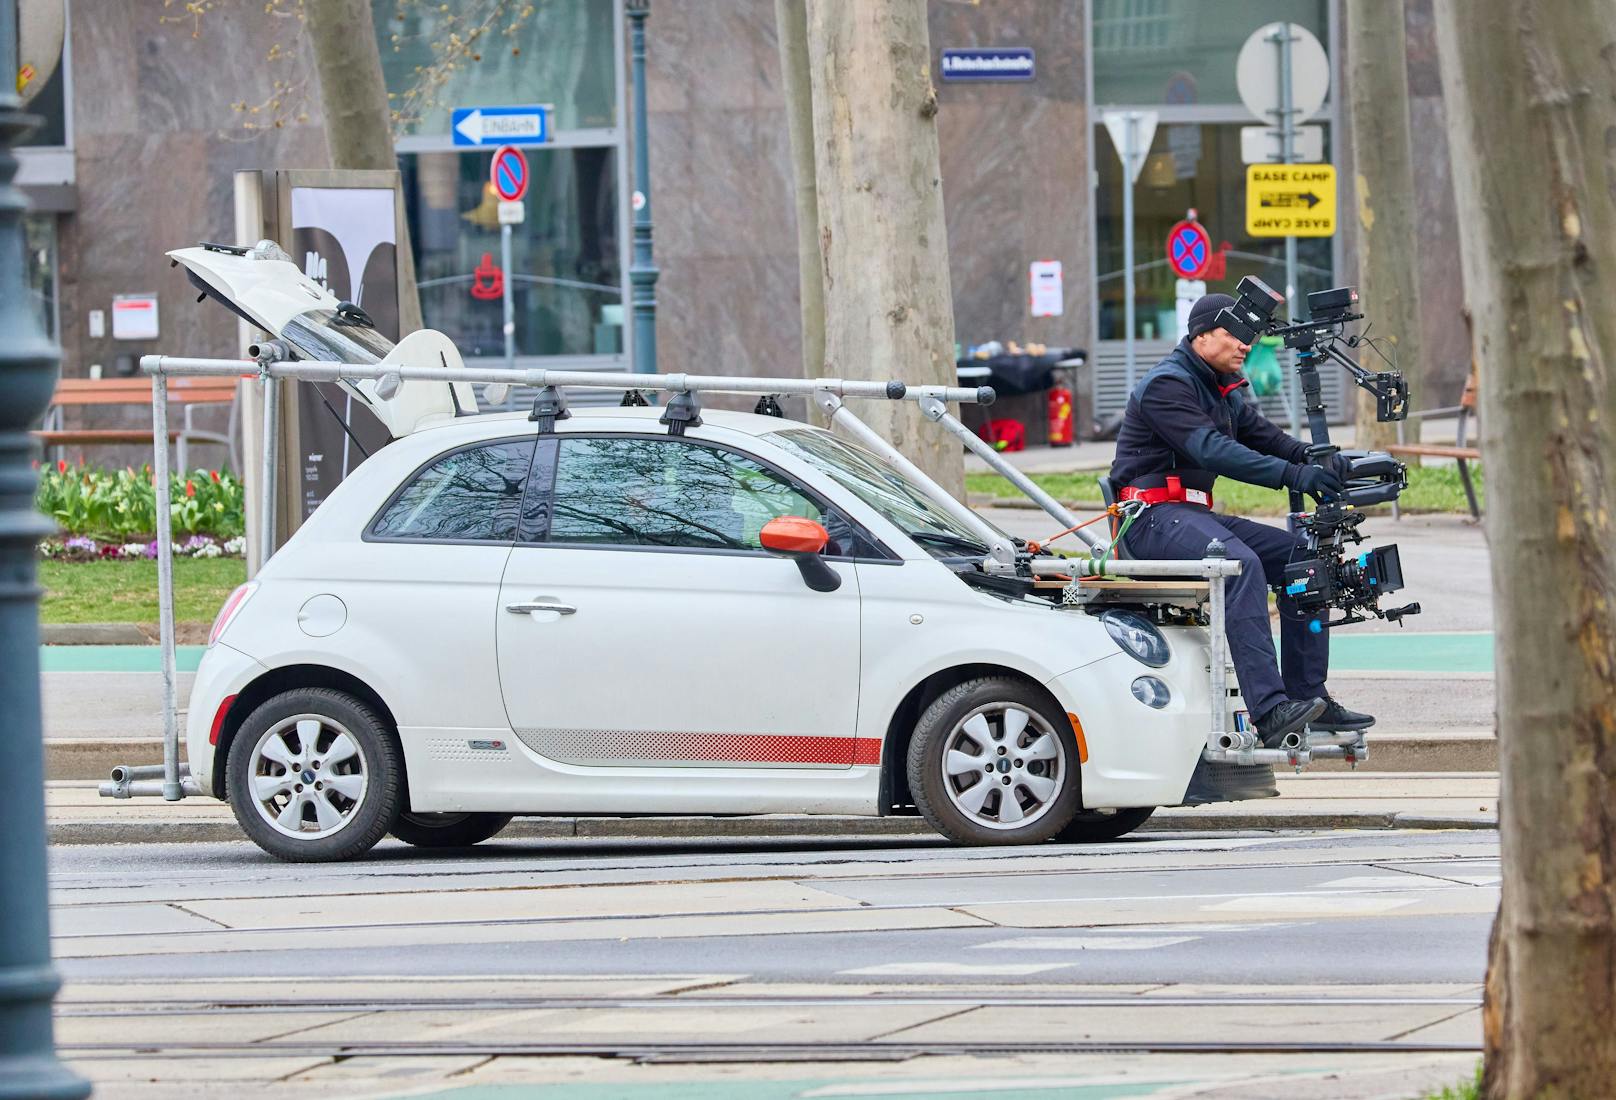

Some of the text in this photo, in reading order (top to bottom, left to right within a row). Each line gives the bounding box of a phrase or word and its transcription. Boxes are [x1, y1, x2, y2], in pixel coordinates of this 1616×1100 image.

[1253, 171, 1330, 181] BASE CAMP
[1253, 218, 1330, 228] BASE CAMP
